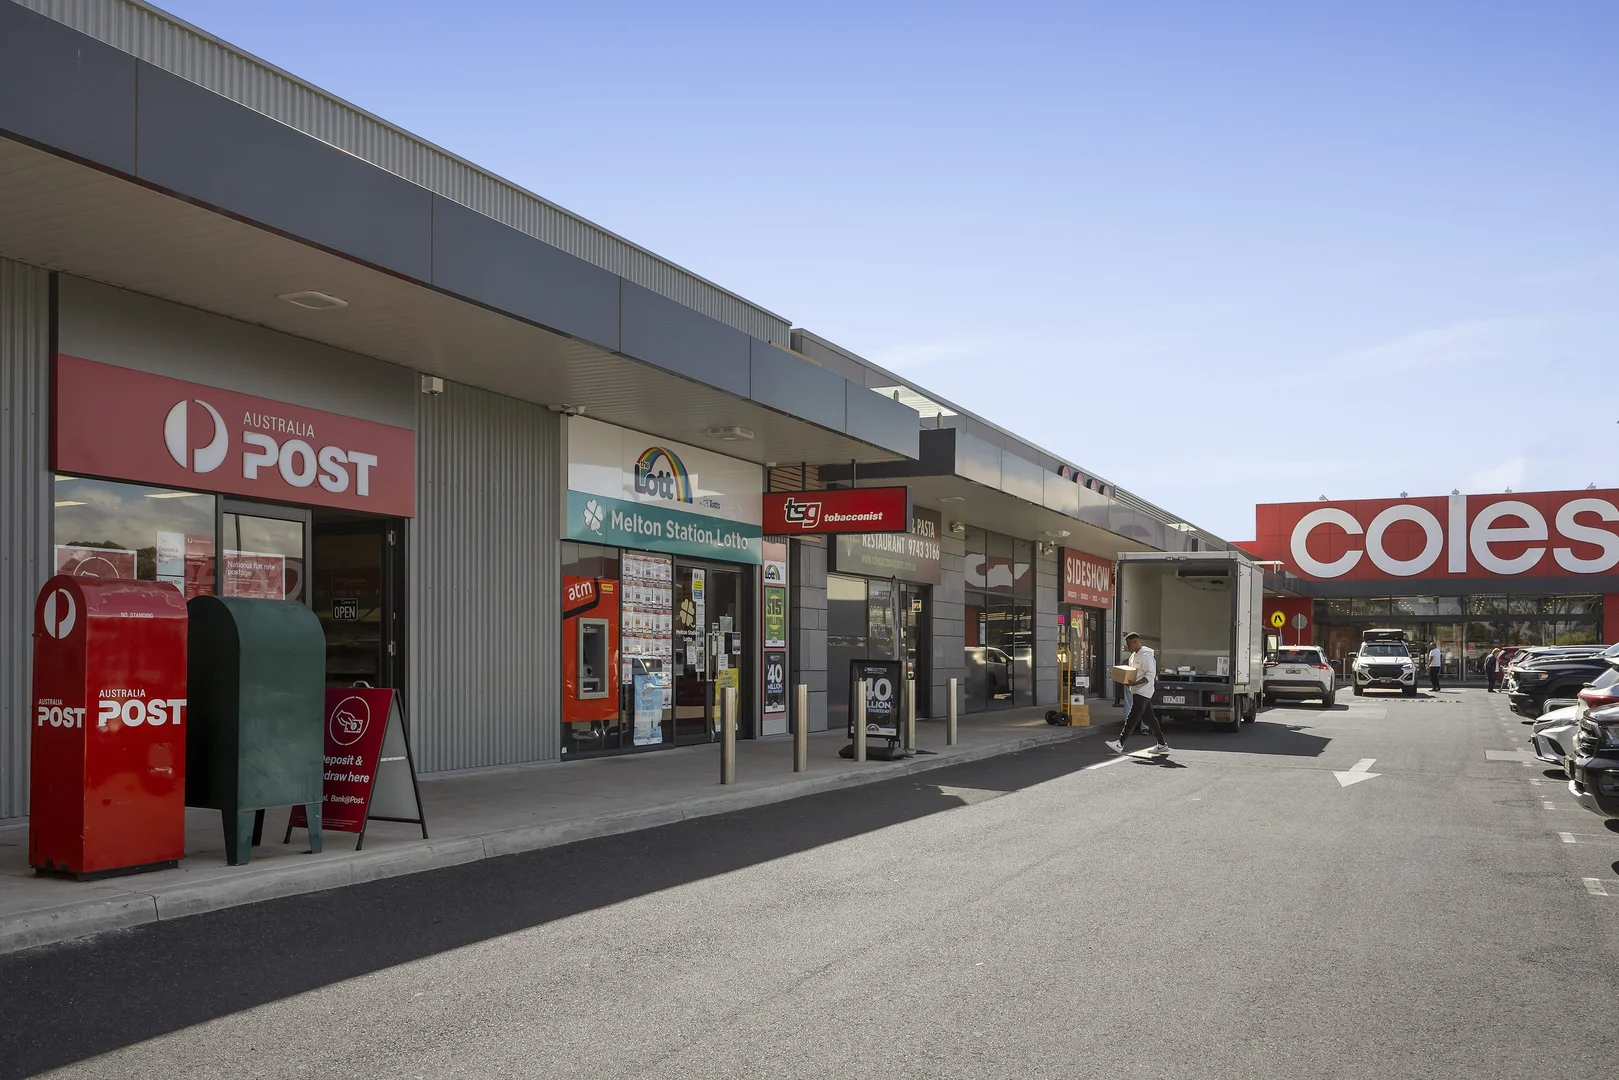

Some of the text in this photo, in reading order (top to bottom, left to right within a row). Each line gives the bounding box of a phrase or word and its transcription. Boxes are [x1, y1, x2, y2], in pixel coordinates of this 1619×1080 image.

[243, 411, 315, 438] AUSTRALIA
[242, 430, 378, 497] POST
[640, 459, 651, 471] the
[634, 463, 674, 500] Lott
[784, 497, 883, 528] tsg tobacconist
[611, 510, 749, 551] Melton Station Lotto
[917, 518, 935, 538] PASTA
[1290, 494, 1619, 578] coles
[862, 534, 905, 554] RESTAURANT
[908, 539, 924, 557] 9743
[925, 542, 940, 561] 3166
[227, 560, 253, 570] National
[253, 562, 265, 570] flat
[227, 569, 252, 577] postage
[1067, 556, 1110, 592] SIDESHOW
[568, 581, 593, 601] atm
[334, 605, 356, 619] OPEN
[98, 689, 147, 699] AUSTRALIA
[867, 700, 891, 709] LLION
[38, 706, 86, 728] POST
[98, 699, 188, 727] POST
[323, 754, 363, 766] eposit &
[324, 769, 370, 783] draw here
